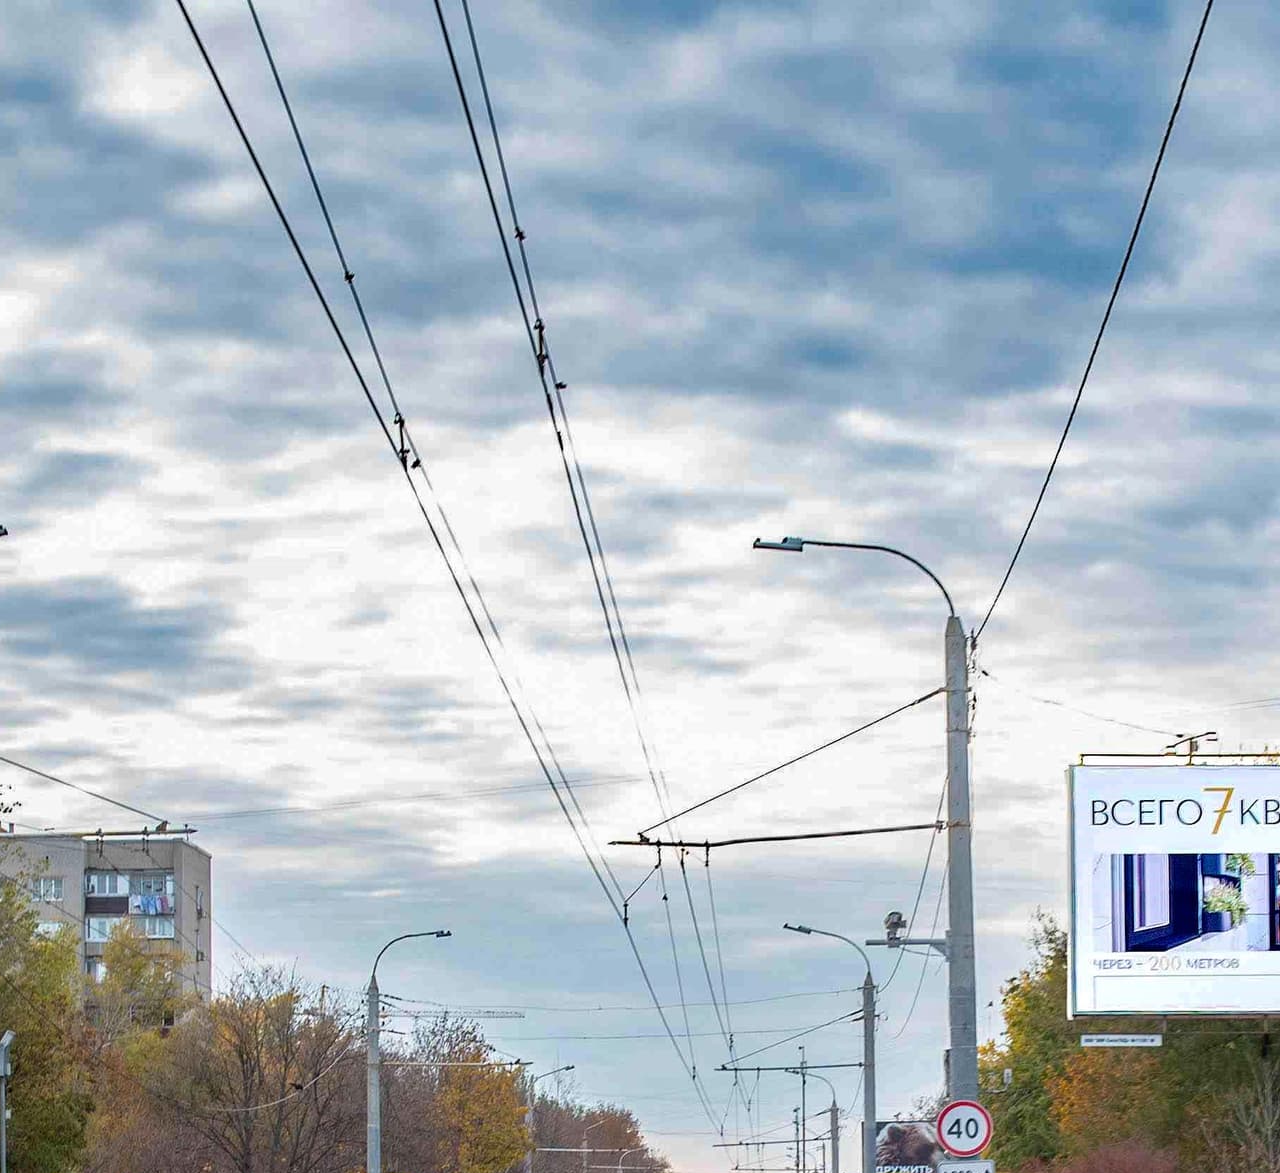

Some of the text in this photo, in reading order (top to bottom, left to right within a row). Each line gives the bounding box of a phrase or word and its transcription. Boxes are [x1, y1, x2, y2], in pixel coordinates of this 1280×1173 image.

[1091, 799, 1203, 826] ВСЕГО
[1204, 787, 1234, 835] 7
[1093, 958, 1133, 970] ЧЕРЕЗ
[1148, 955, 1182, 971] 200
[1185, 957, 1240, 969] МЕТРОВ
[947, 1118, 979, 1139] 40
